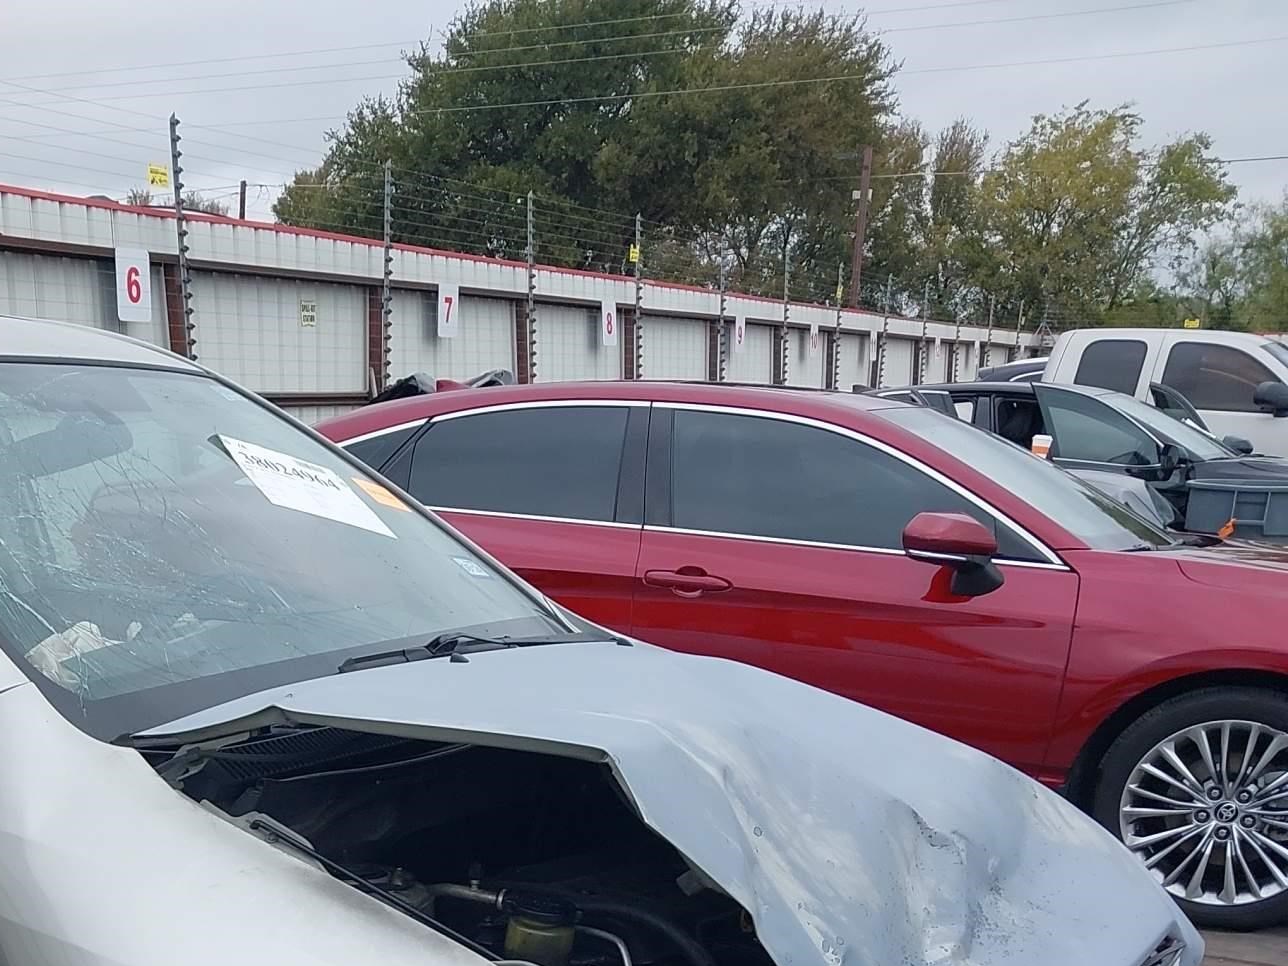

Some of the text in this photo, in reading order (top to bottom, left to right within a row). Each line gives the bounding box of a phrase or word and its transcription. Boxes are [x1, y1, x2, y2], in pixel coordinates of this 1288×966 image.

[126, 266, 142, 304] 6
[444, 296, 453, 323] 7
[606, 312, 613, 335] 8
[737, 325, 743, 345] 9
[810, 332, 818, 350] 10
[238, 451, 341, 491] 38024964
